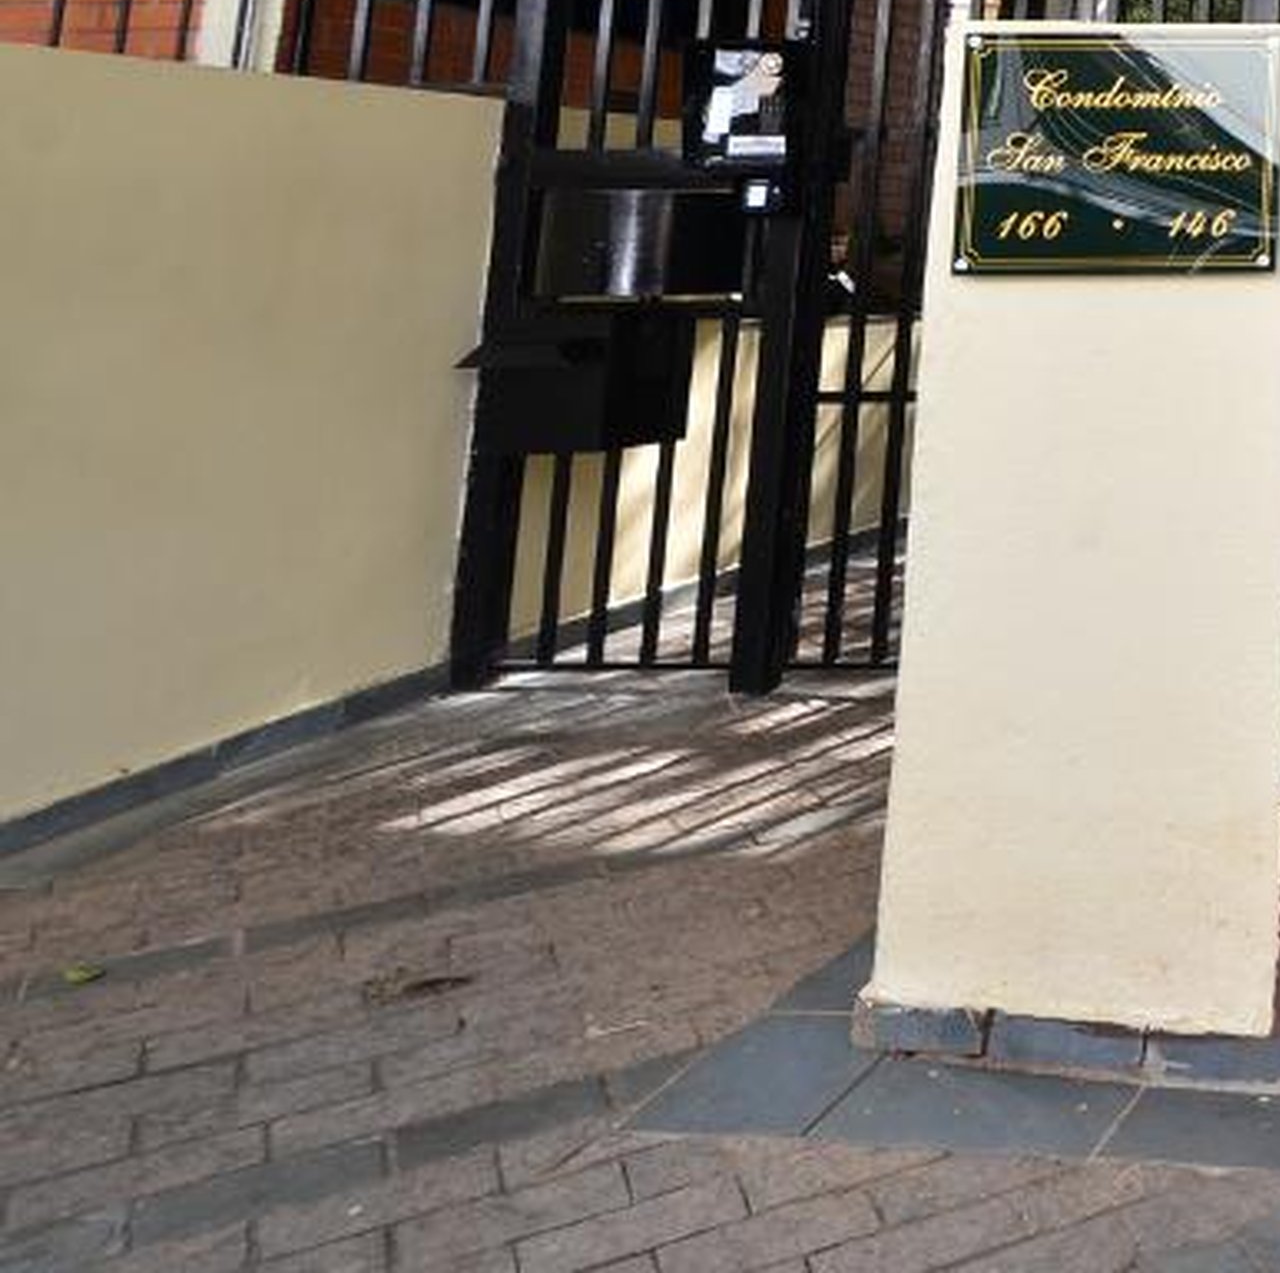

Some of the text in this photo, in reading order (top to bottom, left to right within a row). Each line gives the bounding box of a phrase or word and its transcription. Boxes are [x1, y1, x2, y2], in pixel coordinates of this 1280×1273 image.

[986, 131, 1253, 177] San Francisco
[998, 208, 1237, 240] 166 146
